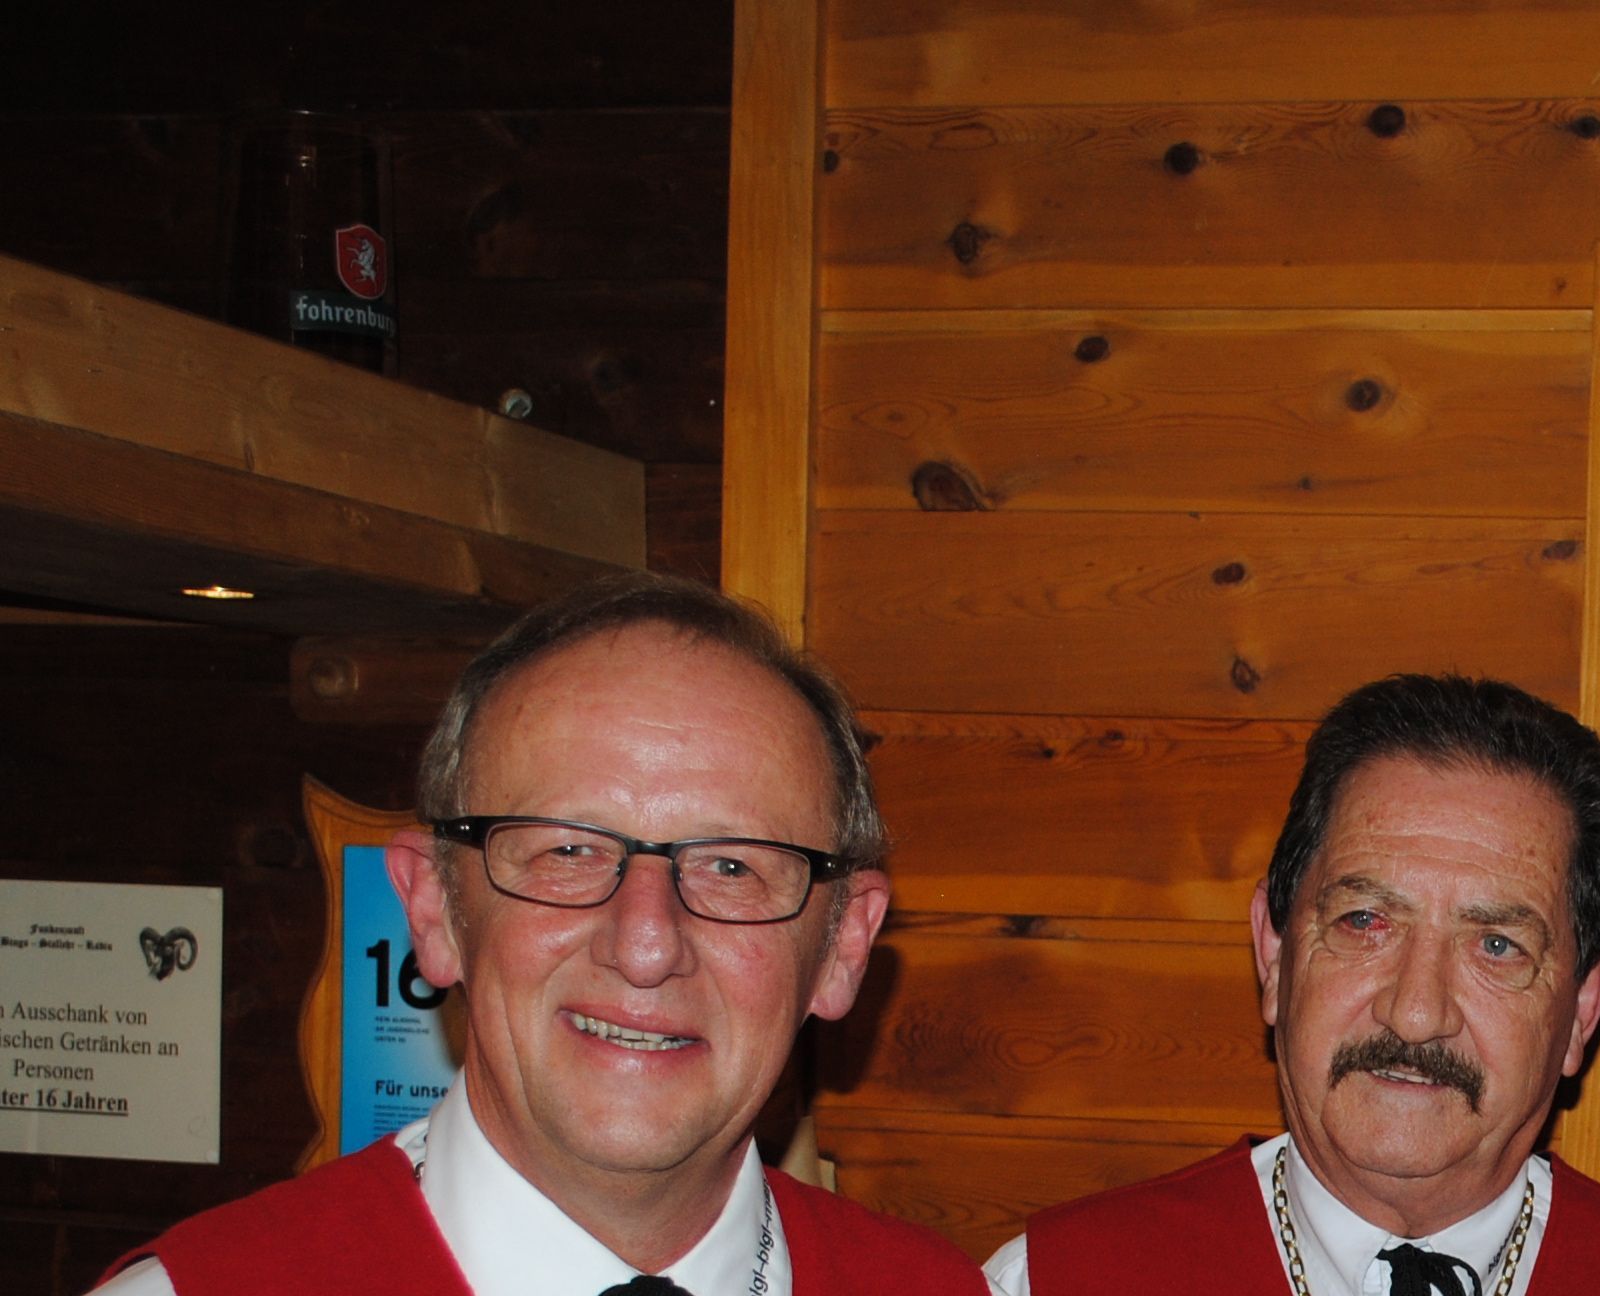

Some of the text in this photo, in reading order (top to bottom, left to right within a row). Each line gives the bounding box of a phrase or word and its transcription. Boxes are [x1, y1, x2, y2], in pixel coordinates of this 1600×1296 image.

[366, 938, 447, 1010] 16
[11, 1002, 108, 1024] Ausschank
[115, 1009, 147, 1025] von
[0, 1029, 179, 1056] ischen Getränken an
[13, 1059, 94, 1081] Personen
[376, 1080, 403, 1096] Für
[36, 1090, 57, 1109] 16
[62, 1092, 128, 1113] Jahren
